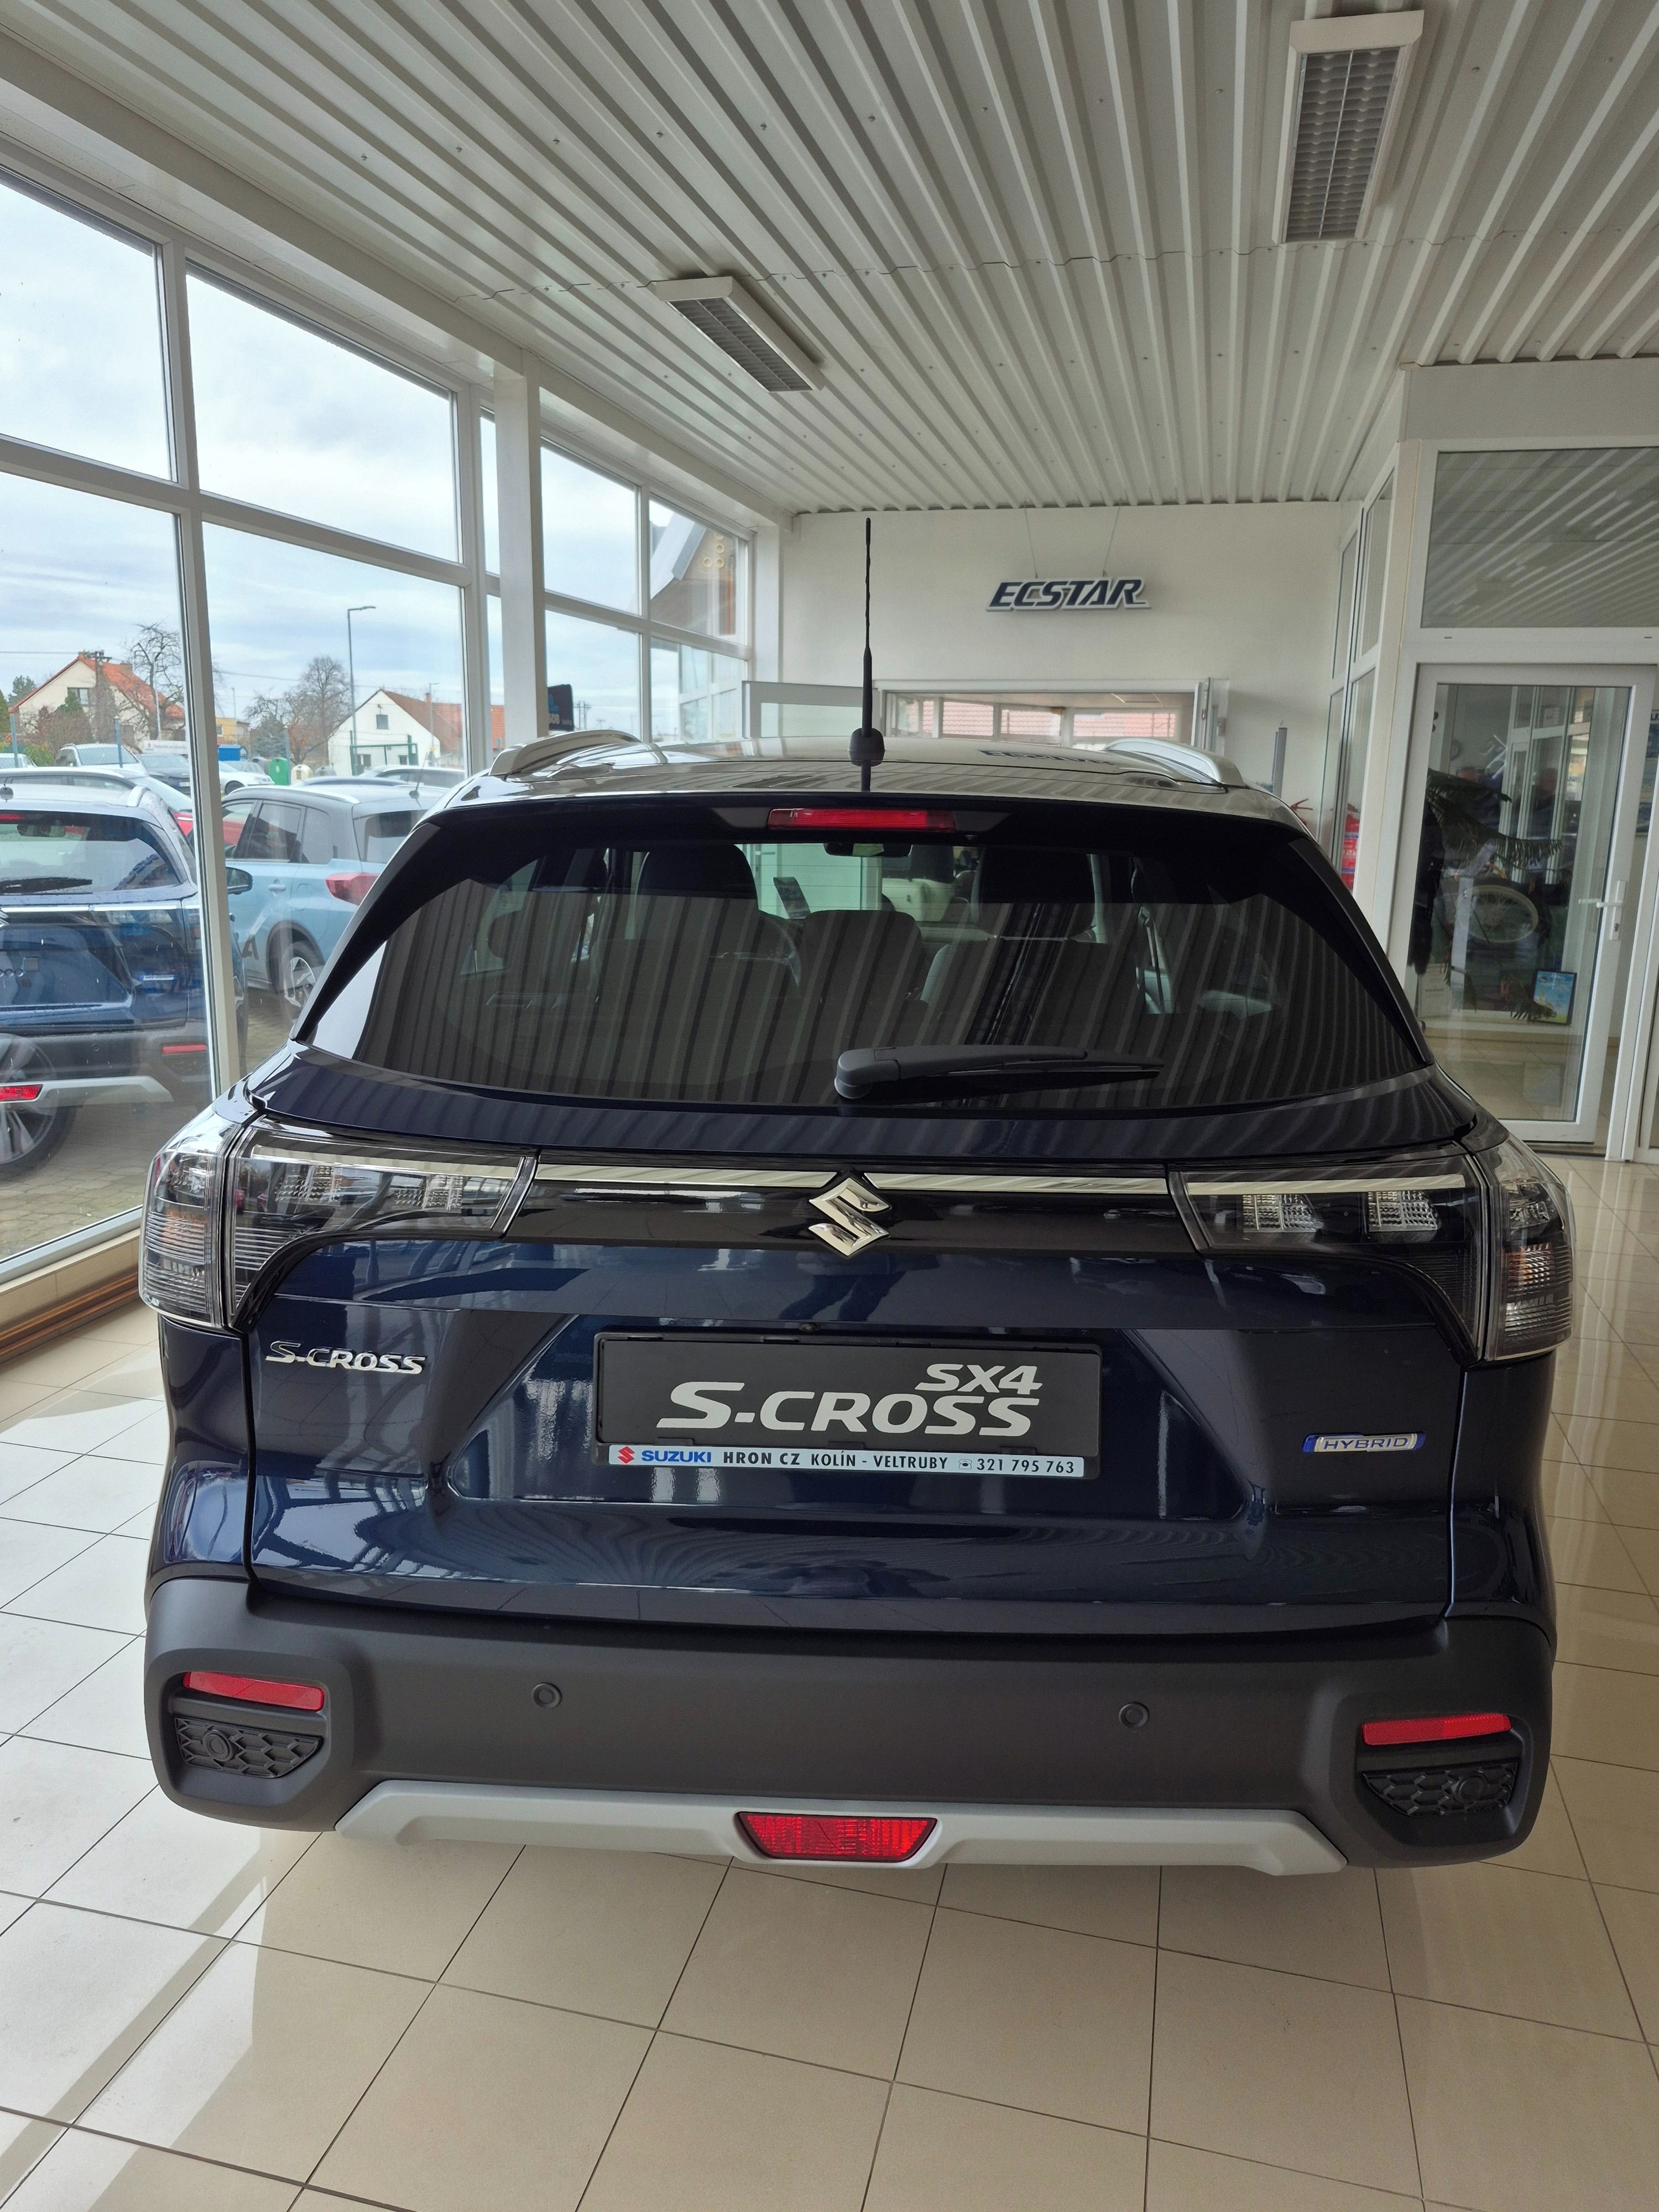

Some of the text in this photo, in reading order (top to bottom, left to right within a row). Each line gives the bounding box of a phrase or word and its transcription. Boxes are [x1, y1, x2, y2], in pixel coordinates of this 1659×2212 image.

[988, 579, 1148, 608] ECSTAR
[265, 1340, 426, 1374] S-CROSS
[914, 1363, 1044, 1395] SX4
[656, 1381, 1040, 1437] S-CROSS
[1323, 1438, 1408, 1450] HYBRID
[641, 1449, 712, 1463] SUZUKI
[723, 1451, 772, 1465] HRON
[779, 1452, 800, 1466] CZ
[811, 1450, 856, 1467] KOLÍN
[873, 1455, 948, 1470] VELTRUBY
[977, 1458, 1003, 1472] 321
[1011, 1459, 1040, 1473] 795
[1046, 1460, 1074, 1474] 763
